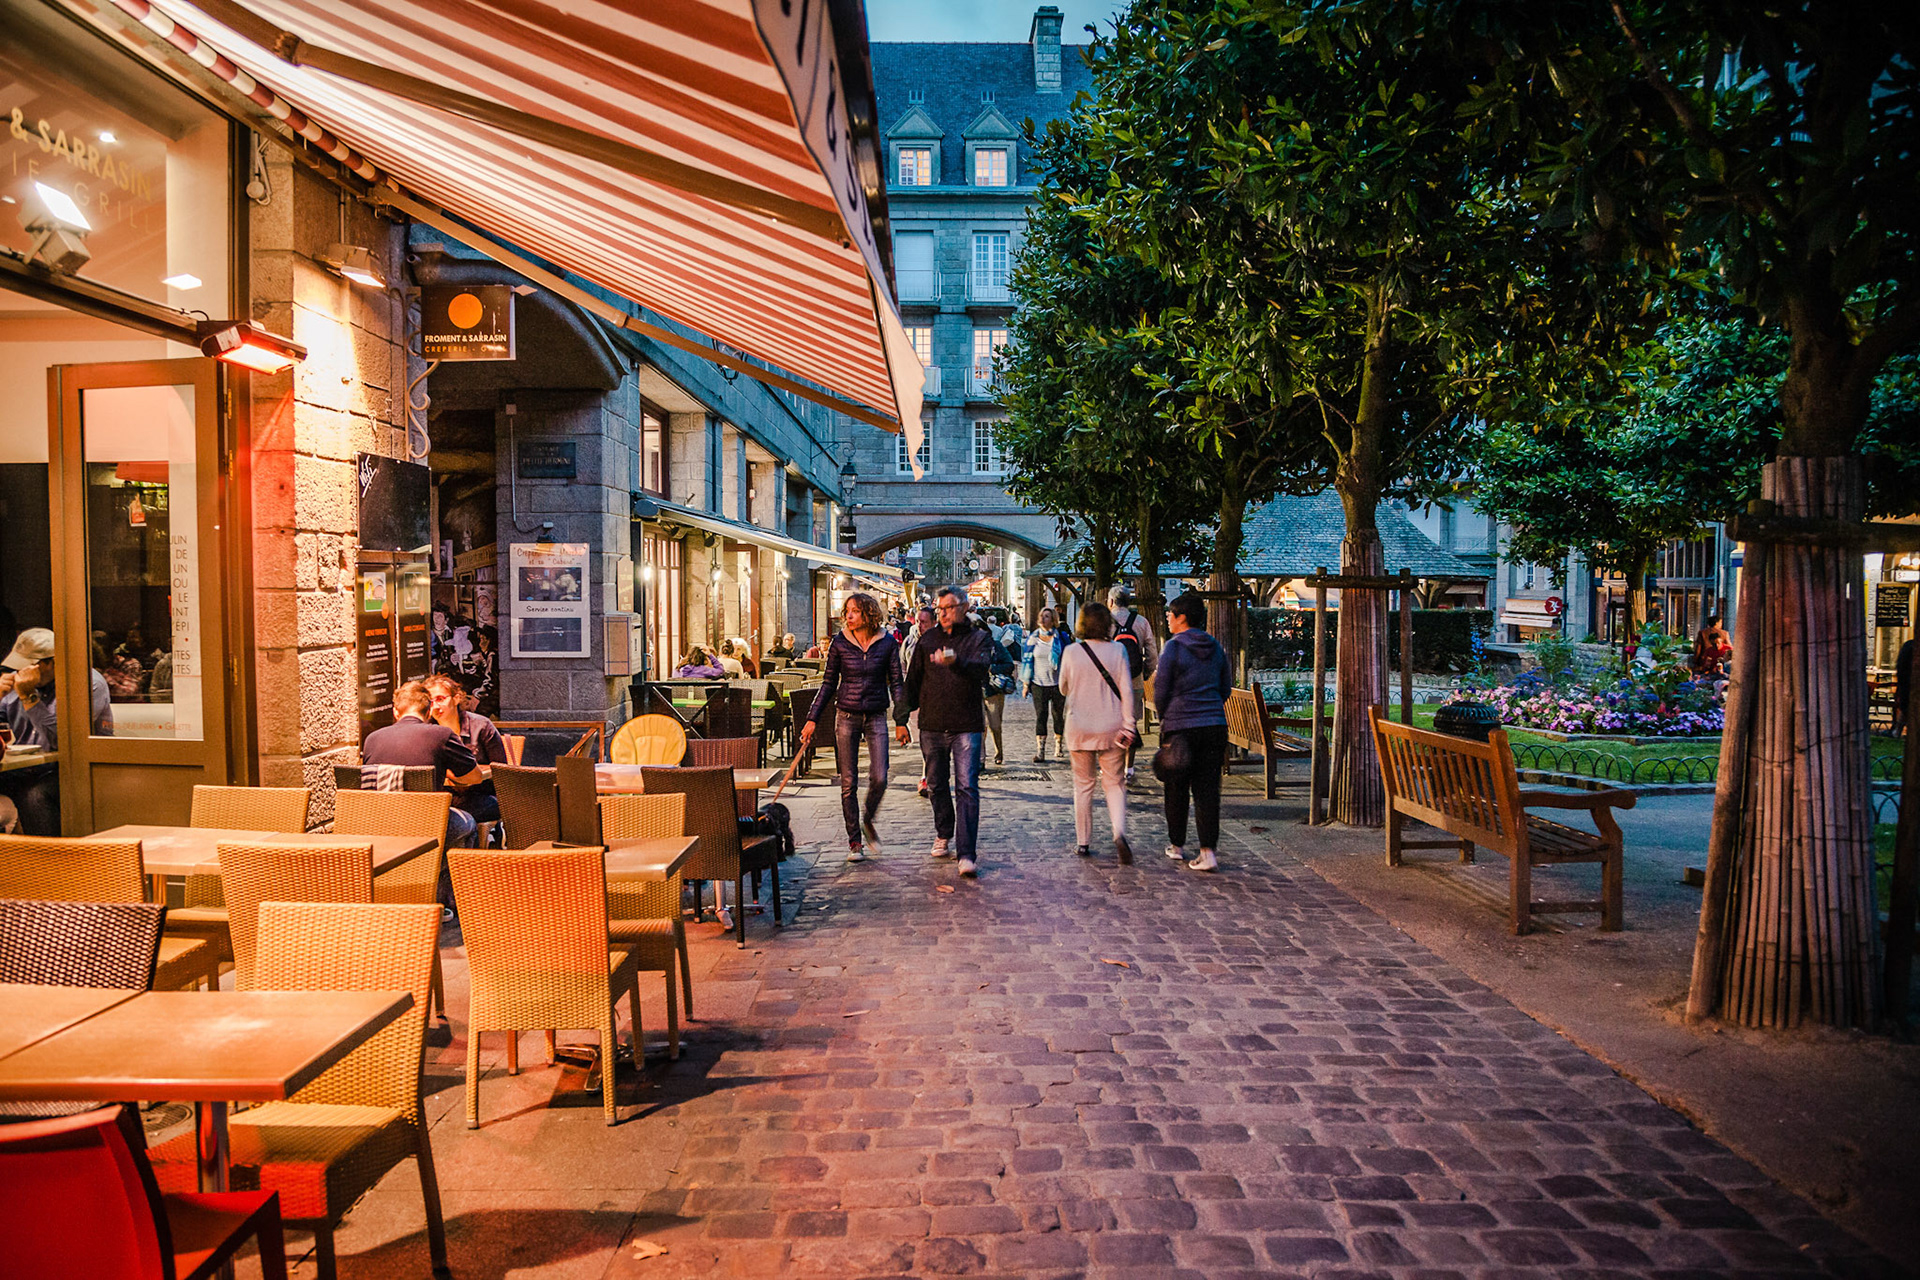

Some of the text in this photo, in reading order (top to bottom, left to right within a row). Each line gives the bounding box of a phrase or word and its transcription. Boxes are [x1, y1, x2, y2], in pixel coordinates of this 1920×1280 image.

[10, 106, 150, 202] & SARRASIN
[424, 333, 507, 343] FROMENT & SARRASIN
[175, 549, 188, 559] DE
[173, 564, 188, 574] UN
[172, 577, 188, 588] OU
[178, 592, 188, 602] LE
